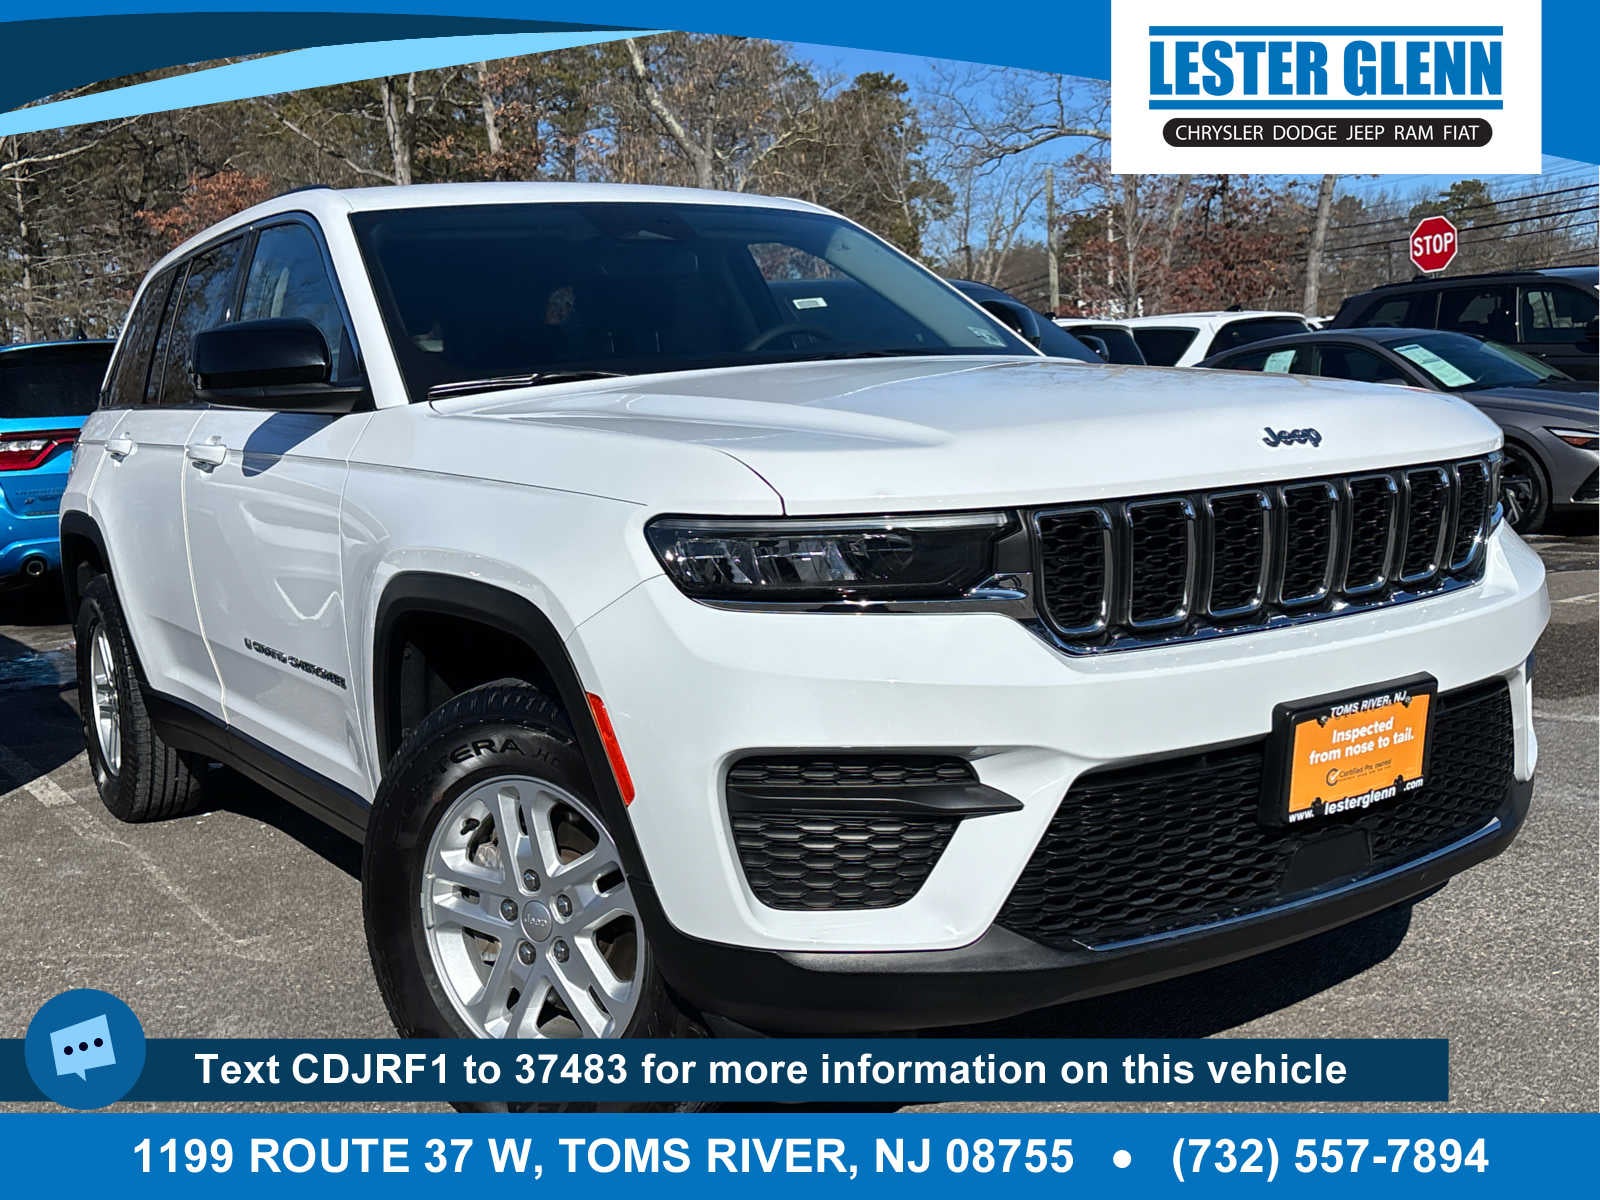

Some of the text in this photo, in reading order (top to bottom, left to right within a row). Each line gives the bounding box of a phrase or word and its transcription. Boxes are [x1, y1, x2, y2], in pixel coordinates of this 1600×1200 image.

[1413, 232, 1454, 257] STOP
[1262, 427, 1322, 448] Jeep
[1330, 691, 1407, 718] TOMS RIVER, NJ
[1332, 716, 1394, 744] Inspected
[1309, 728, 1414, 765] from nose to tail.
[1289, 809, 1315, 823] www.
[1324, 786, 1396, 815] lesterglenn
